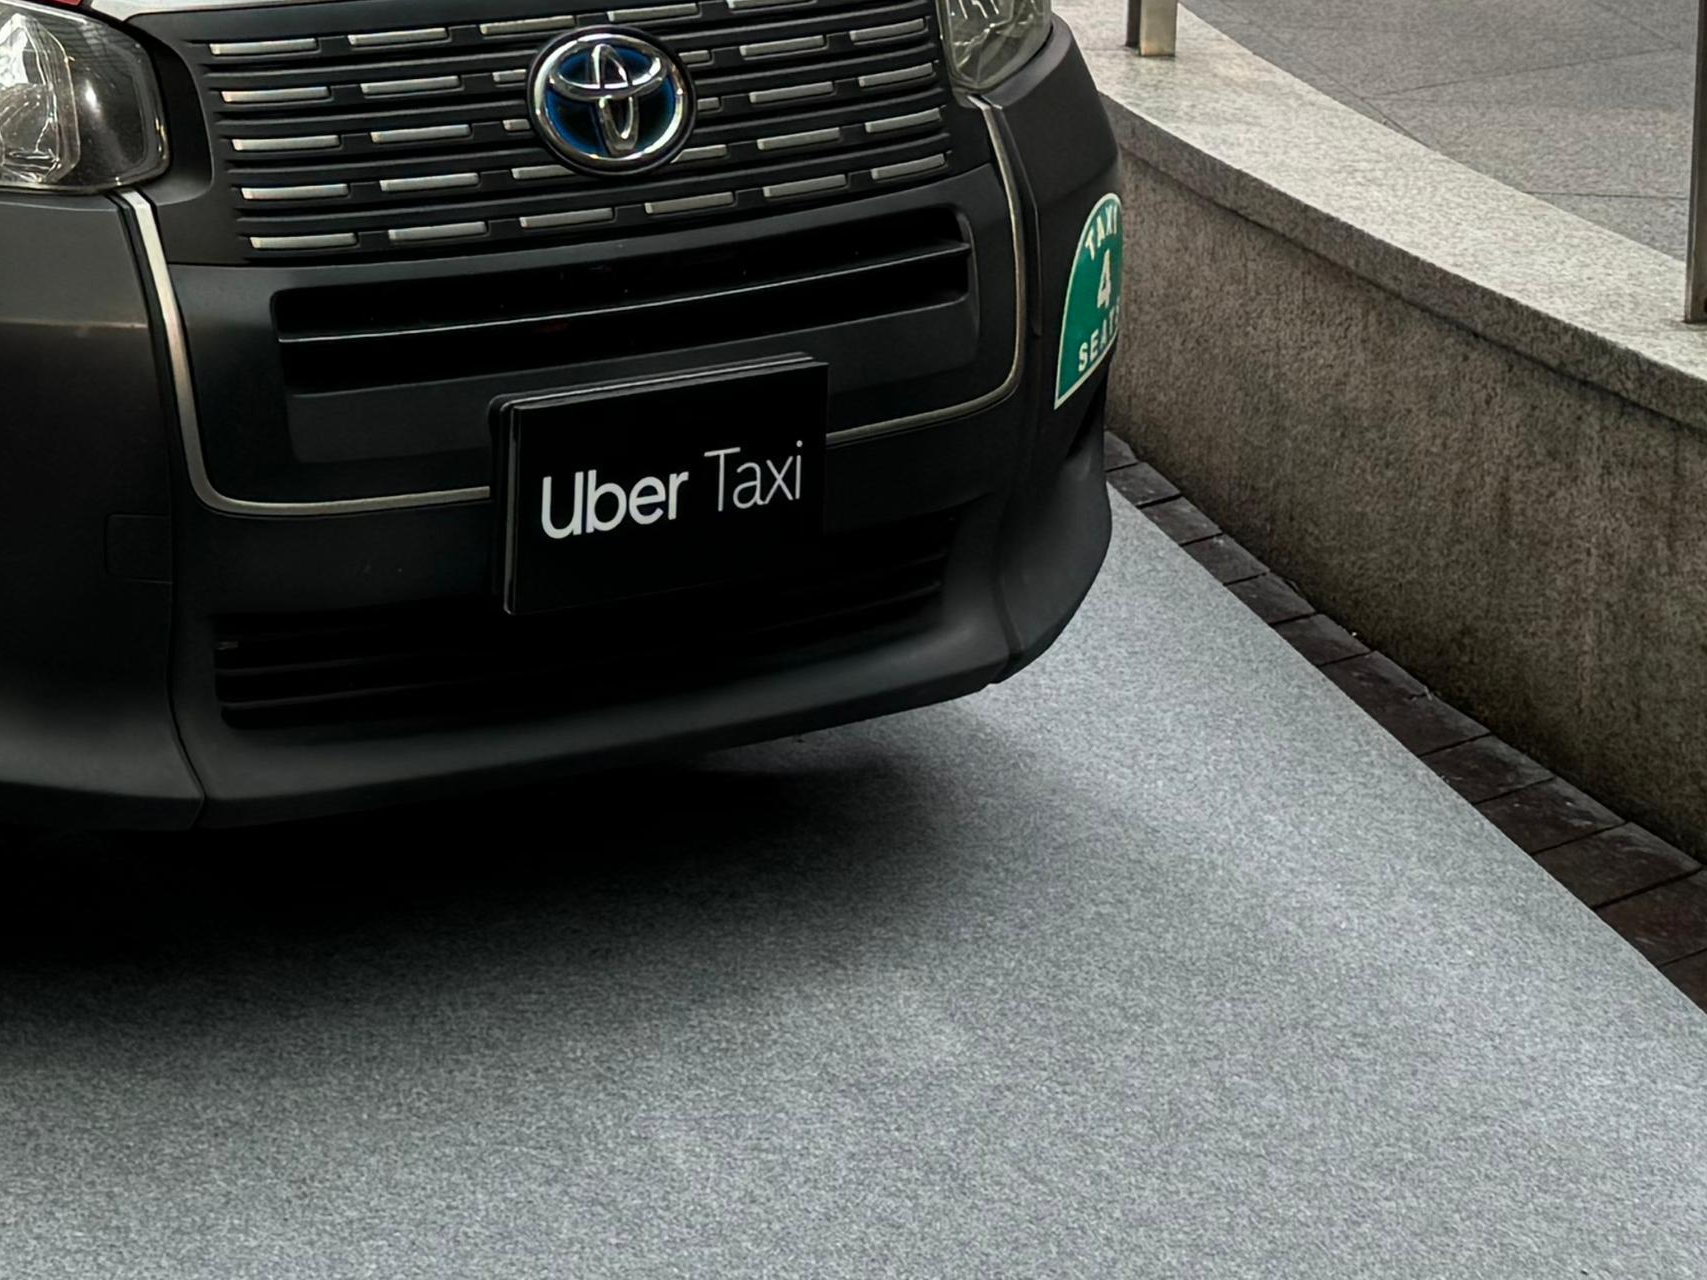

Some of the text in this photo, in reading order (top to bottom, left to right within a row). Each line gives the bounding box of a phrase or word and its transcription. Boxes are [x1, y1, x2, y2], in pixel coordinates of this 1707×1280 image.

[1085, 205, 1118, 260] TAXI
[1096, 248, 1112, 309] 4
[541, 440, 803, 540] Uber Taxi
